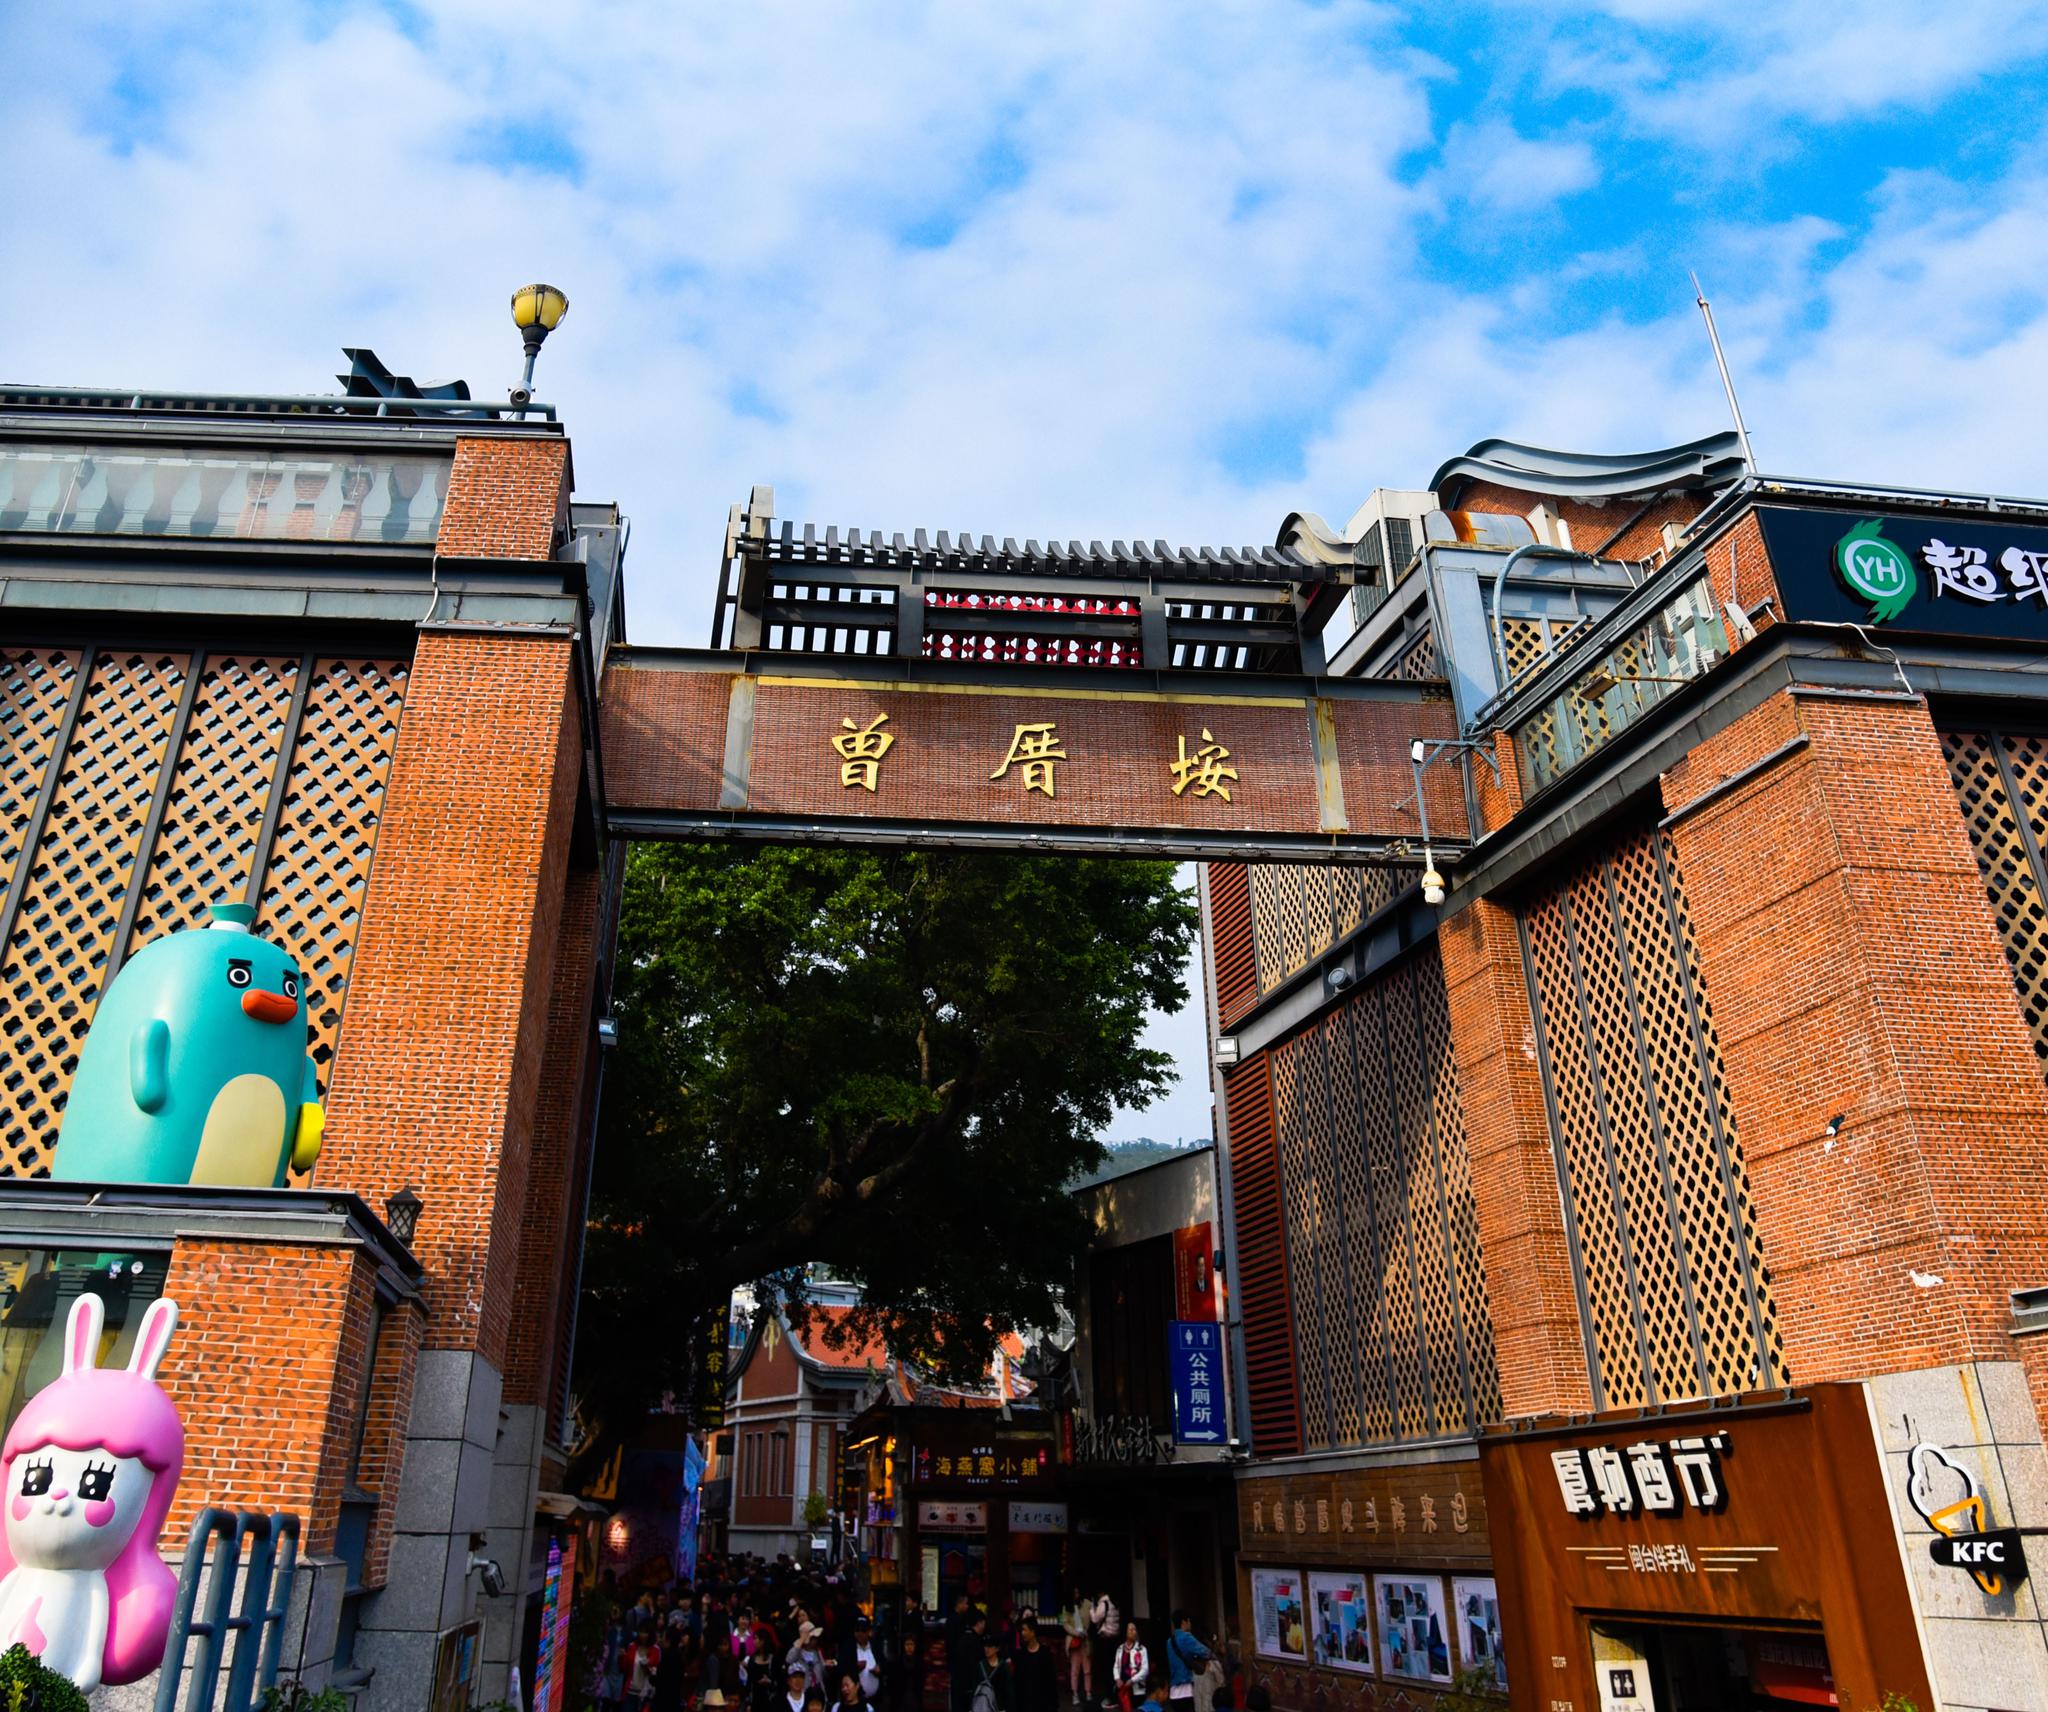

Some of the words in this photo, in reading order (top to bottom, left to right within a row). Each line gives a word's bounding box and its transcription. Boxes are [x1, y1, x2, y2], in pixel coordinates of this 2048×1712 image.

[1855, 556, 1899, 583] YH
[831, 712, 1238, 802] 曾厝垵
[1187, 1351, 1213, 1425] 公共厕所
[1628, 1544, 1696, 1573] 闽台伴手礼
[1952, 1541, 2005, 1562] KFC
